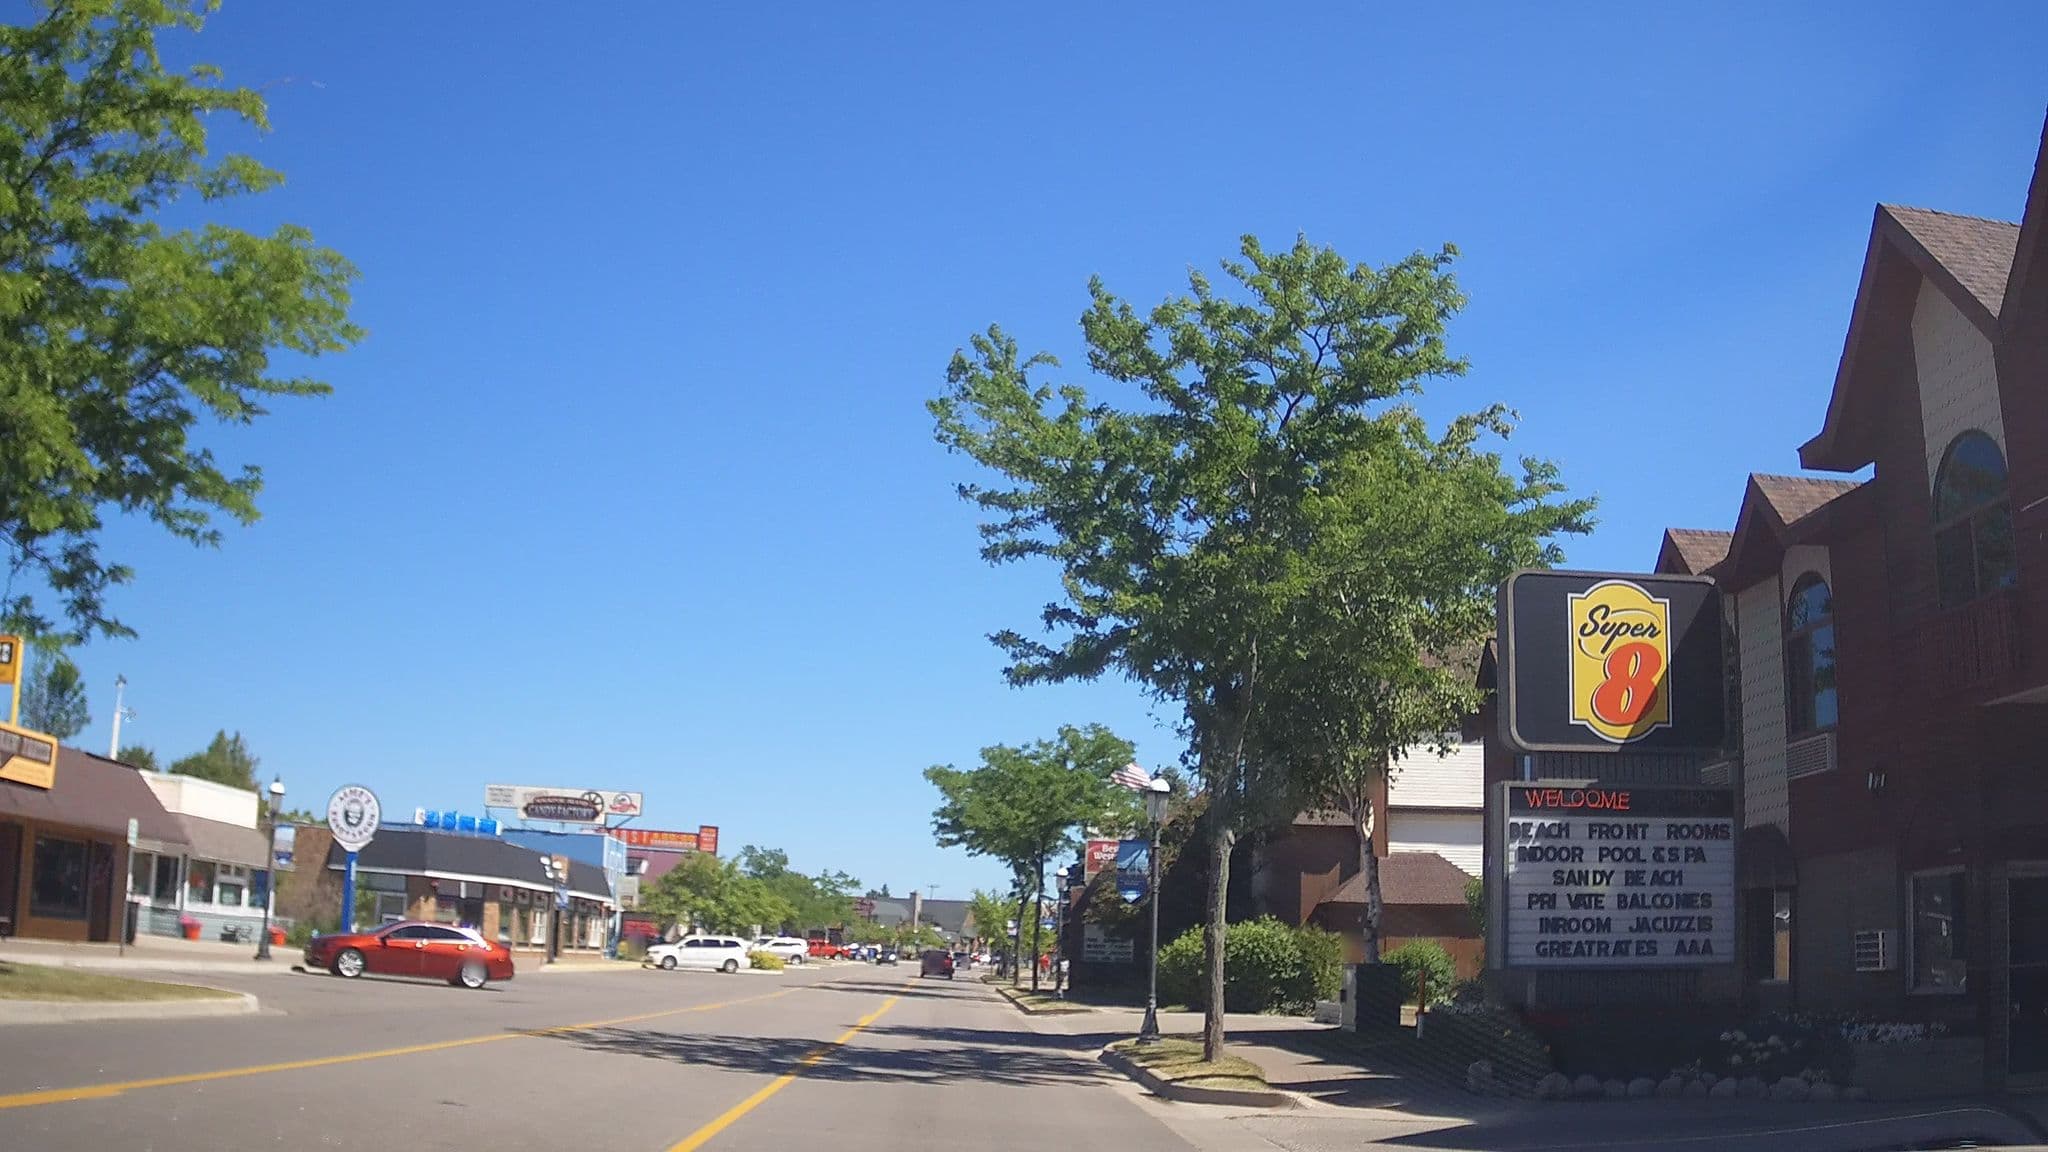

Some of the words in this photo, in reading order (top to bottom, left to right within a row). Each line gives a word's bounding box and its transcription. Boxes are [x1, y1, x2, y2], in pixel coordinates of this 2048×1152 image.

[1579, 604, 1661, 655] Super
[1590, 642, 1662, 727] 8
[1525, 789, 1631, 810] WELCOME
[1509, 822, 1569, 840] BEACH
[1588, 823, 1649, 840] FRONT
[1666, 823, 1731, 841] ROOMS
[1598, 846, 1647, 864] POOL
[1552, 869, 1615, 887] SANDY
[1624, 869, 1683, 887] BEACH
[1628, 916, 1714, 934] JACUZZIS
[1675, 939, 1714, 957] AAA
